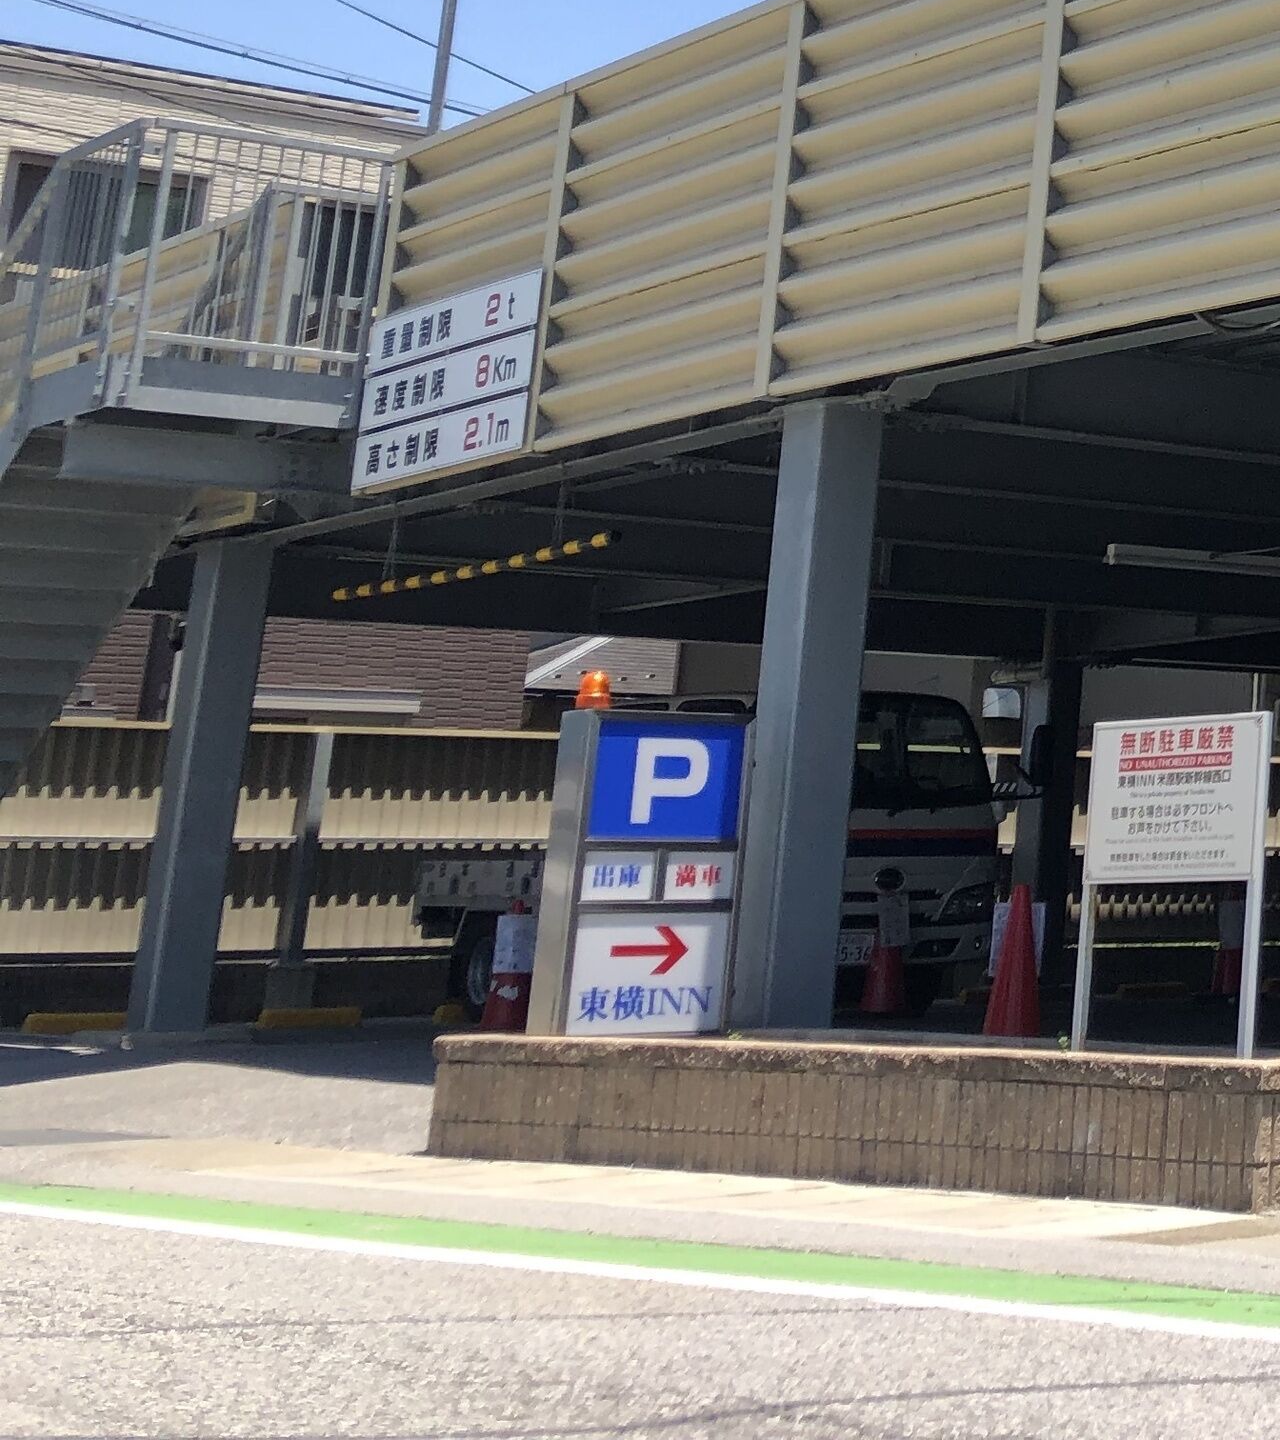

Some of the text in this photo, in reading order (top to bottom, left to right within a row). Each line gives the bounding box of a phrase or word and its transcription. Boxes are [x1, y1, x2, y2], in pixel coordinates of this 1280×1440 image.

[381, 308, 452, 359] 重量制限
[374, 354, 517, 416] 速度制限 8Km
[366, 412, 510, 476] 高さ制限 2.1m
[1120, 725, 1235, 755] 無断駐車厳禁
[629, 737, 710, 825] P
[592, 864, 641, 889] 出庫
[675, 864, 722, 889] 満車
[576, 985, 713, 1023] 東横INN
